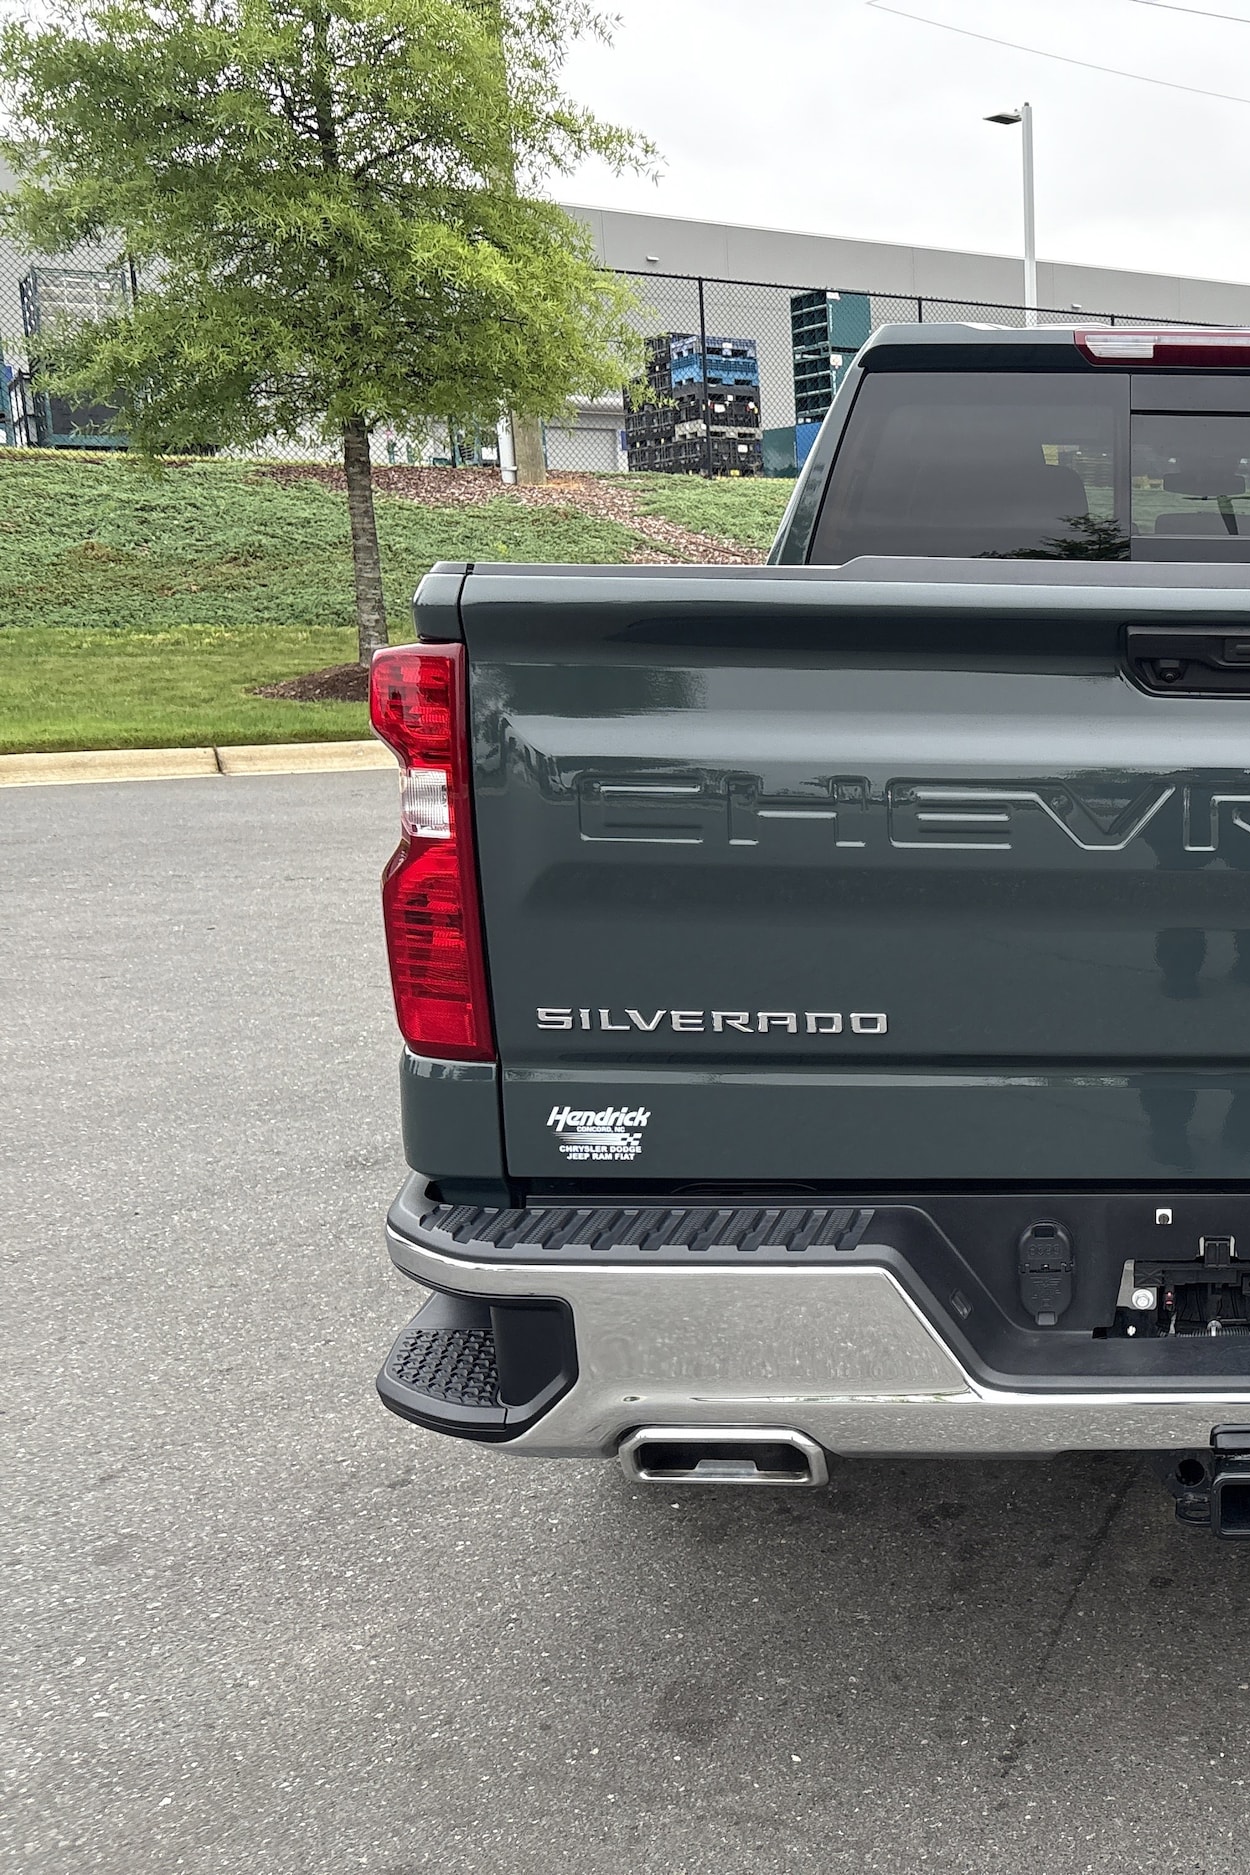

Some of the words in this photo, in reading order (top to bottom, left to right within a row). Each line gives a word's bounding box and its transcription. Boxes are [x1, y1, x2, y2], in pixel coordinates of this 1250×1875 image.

[536, 1007, 888, 1035] SILVERADO
[546, 1106, 652, 1132] Hendrick
[559, 1145, 608, 1153] CHRYSLER
[609, 1145, 642, 1153] DODGE
